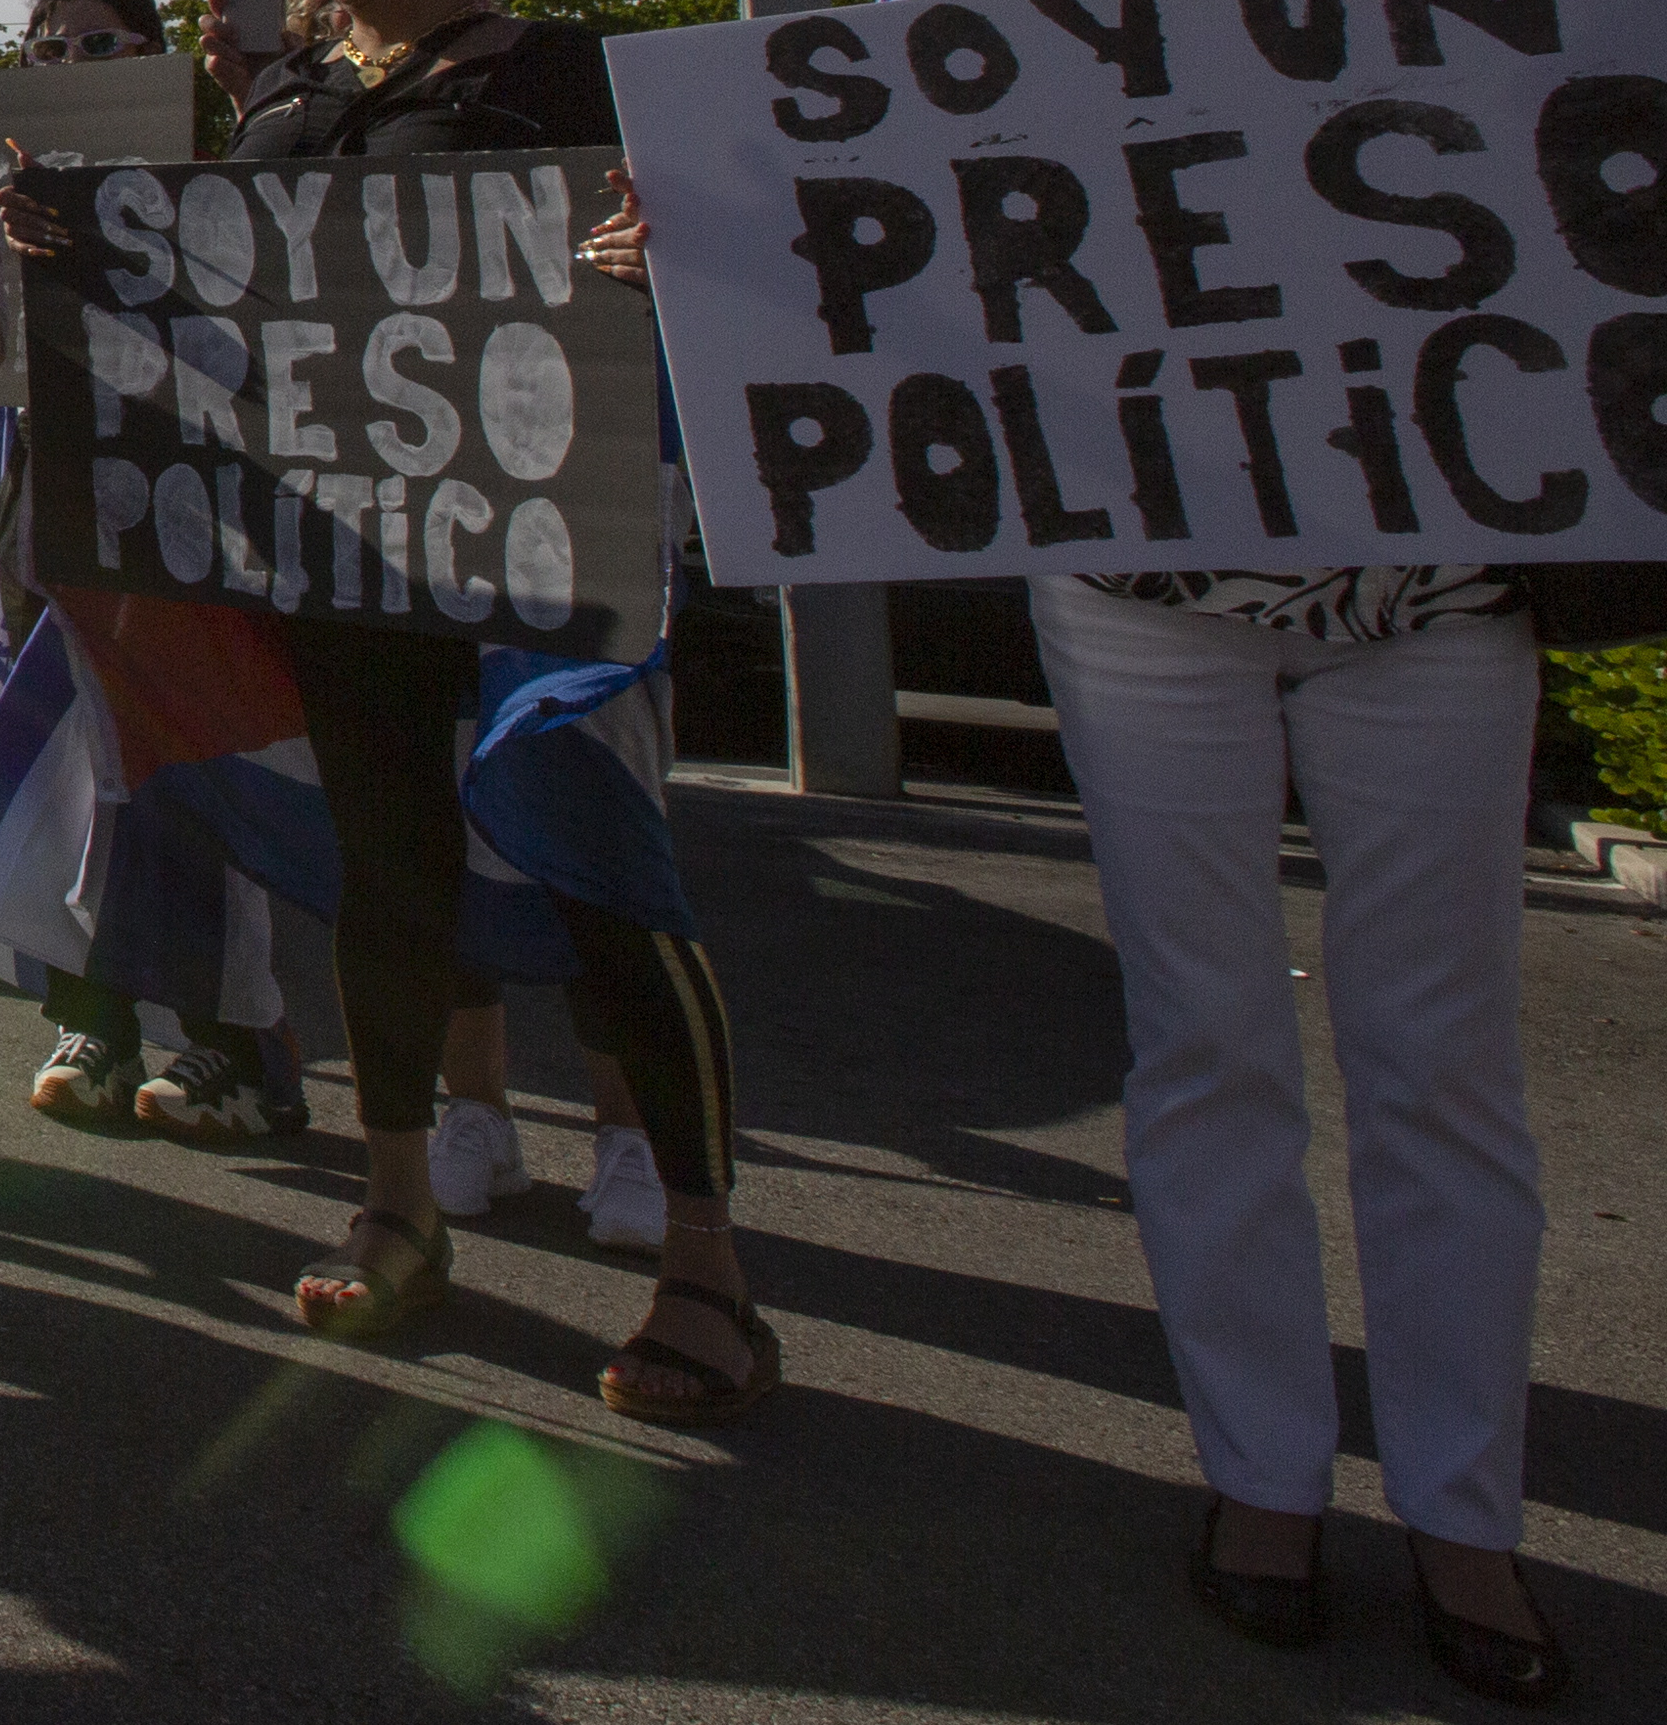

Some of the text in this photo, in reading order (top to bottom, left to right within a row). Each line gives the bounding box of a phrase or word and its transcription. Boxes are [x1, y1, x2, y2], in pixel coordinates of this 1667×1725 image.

[94, 165, 572, 308] SOY UN
[790, 74, 1667, 356] PRESO
[82, 304, 573, 481] PRESO
